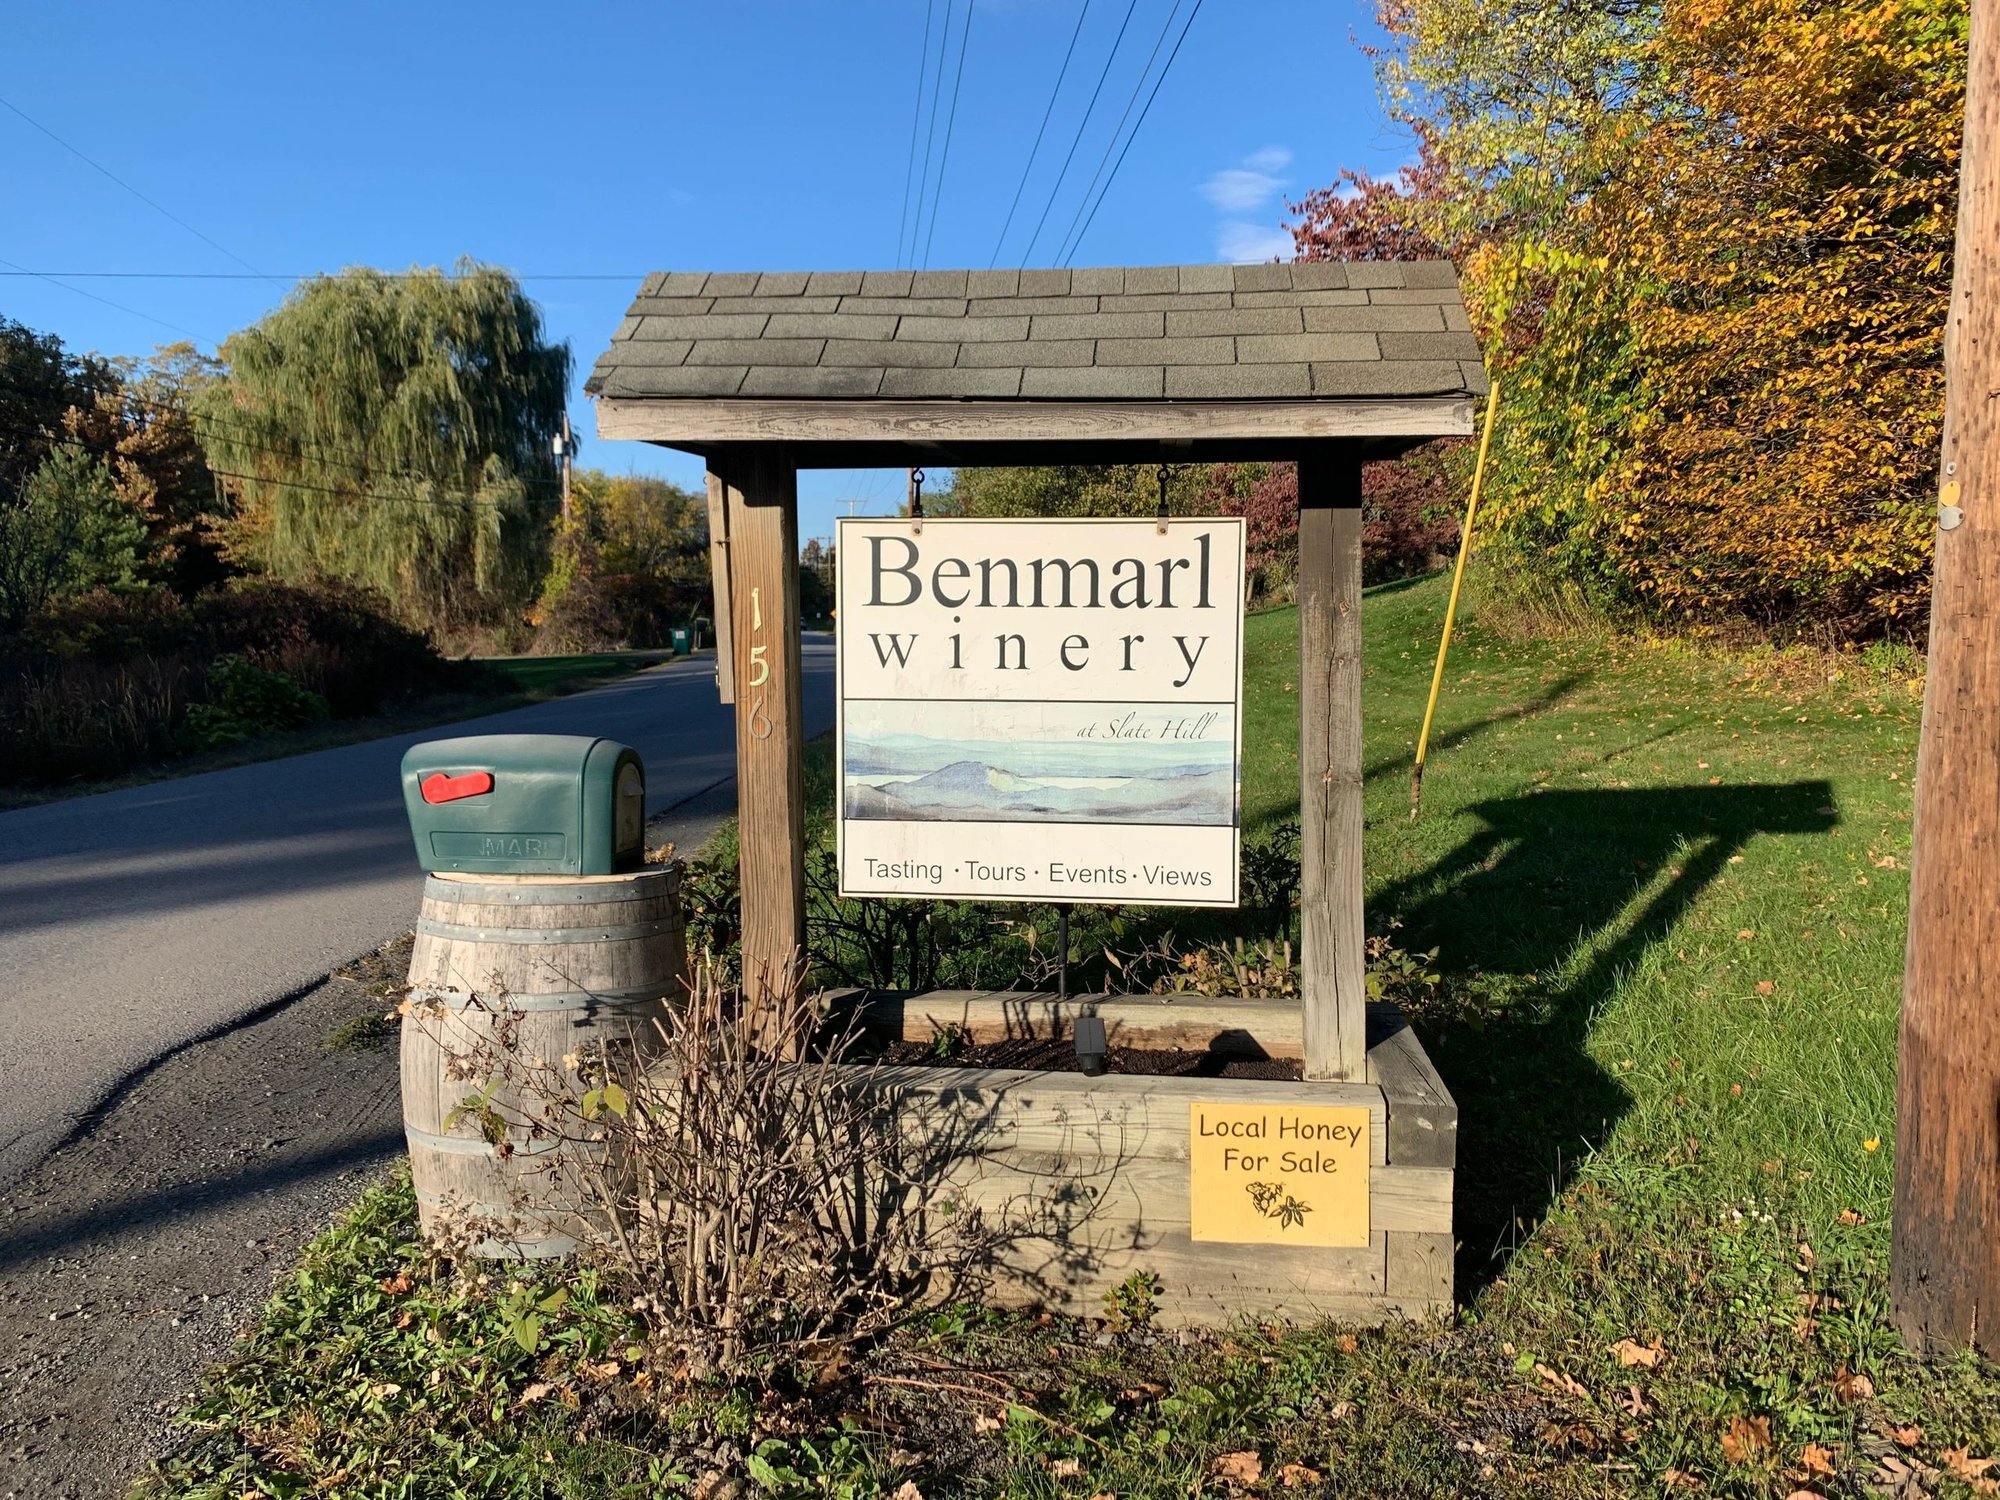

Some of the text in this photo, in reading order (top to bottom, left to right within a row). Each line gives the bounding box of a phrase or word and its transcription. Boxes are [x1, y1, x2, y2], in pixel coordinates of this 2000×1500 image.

[862, 533, 1216, 609] Benmarl
[750, 587, 773, 740] 156
[867, 616, 1210, 688] winery
[1076, 711, 1218, 740] at Slate Hill
[864, 858, 1213, 886] Tasting Tours Events Views
[1200, 1114, 1362, 1148] Local Honey
[1224, 1148, 1337, 1173] For Sale
